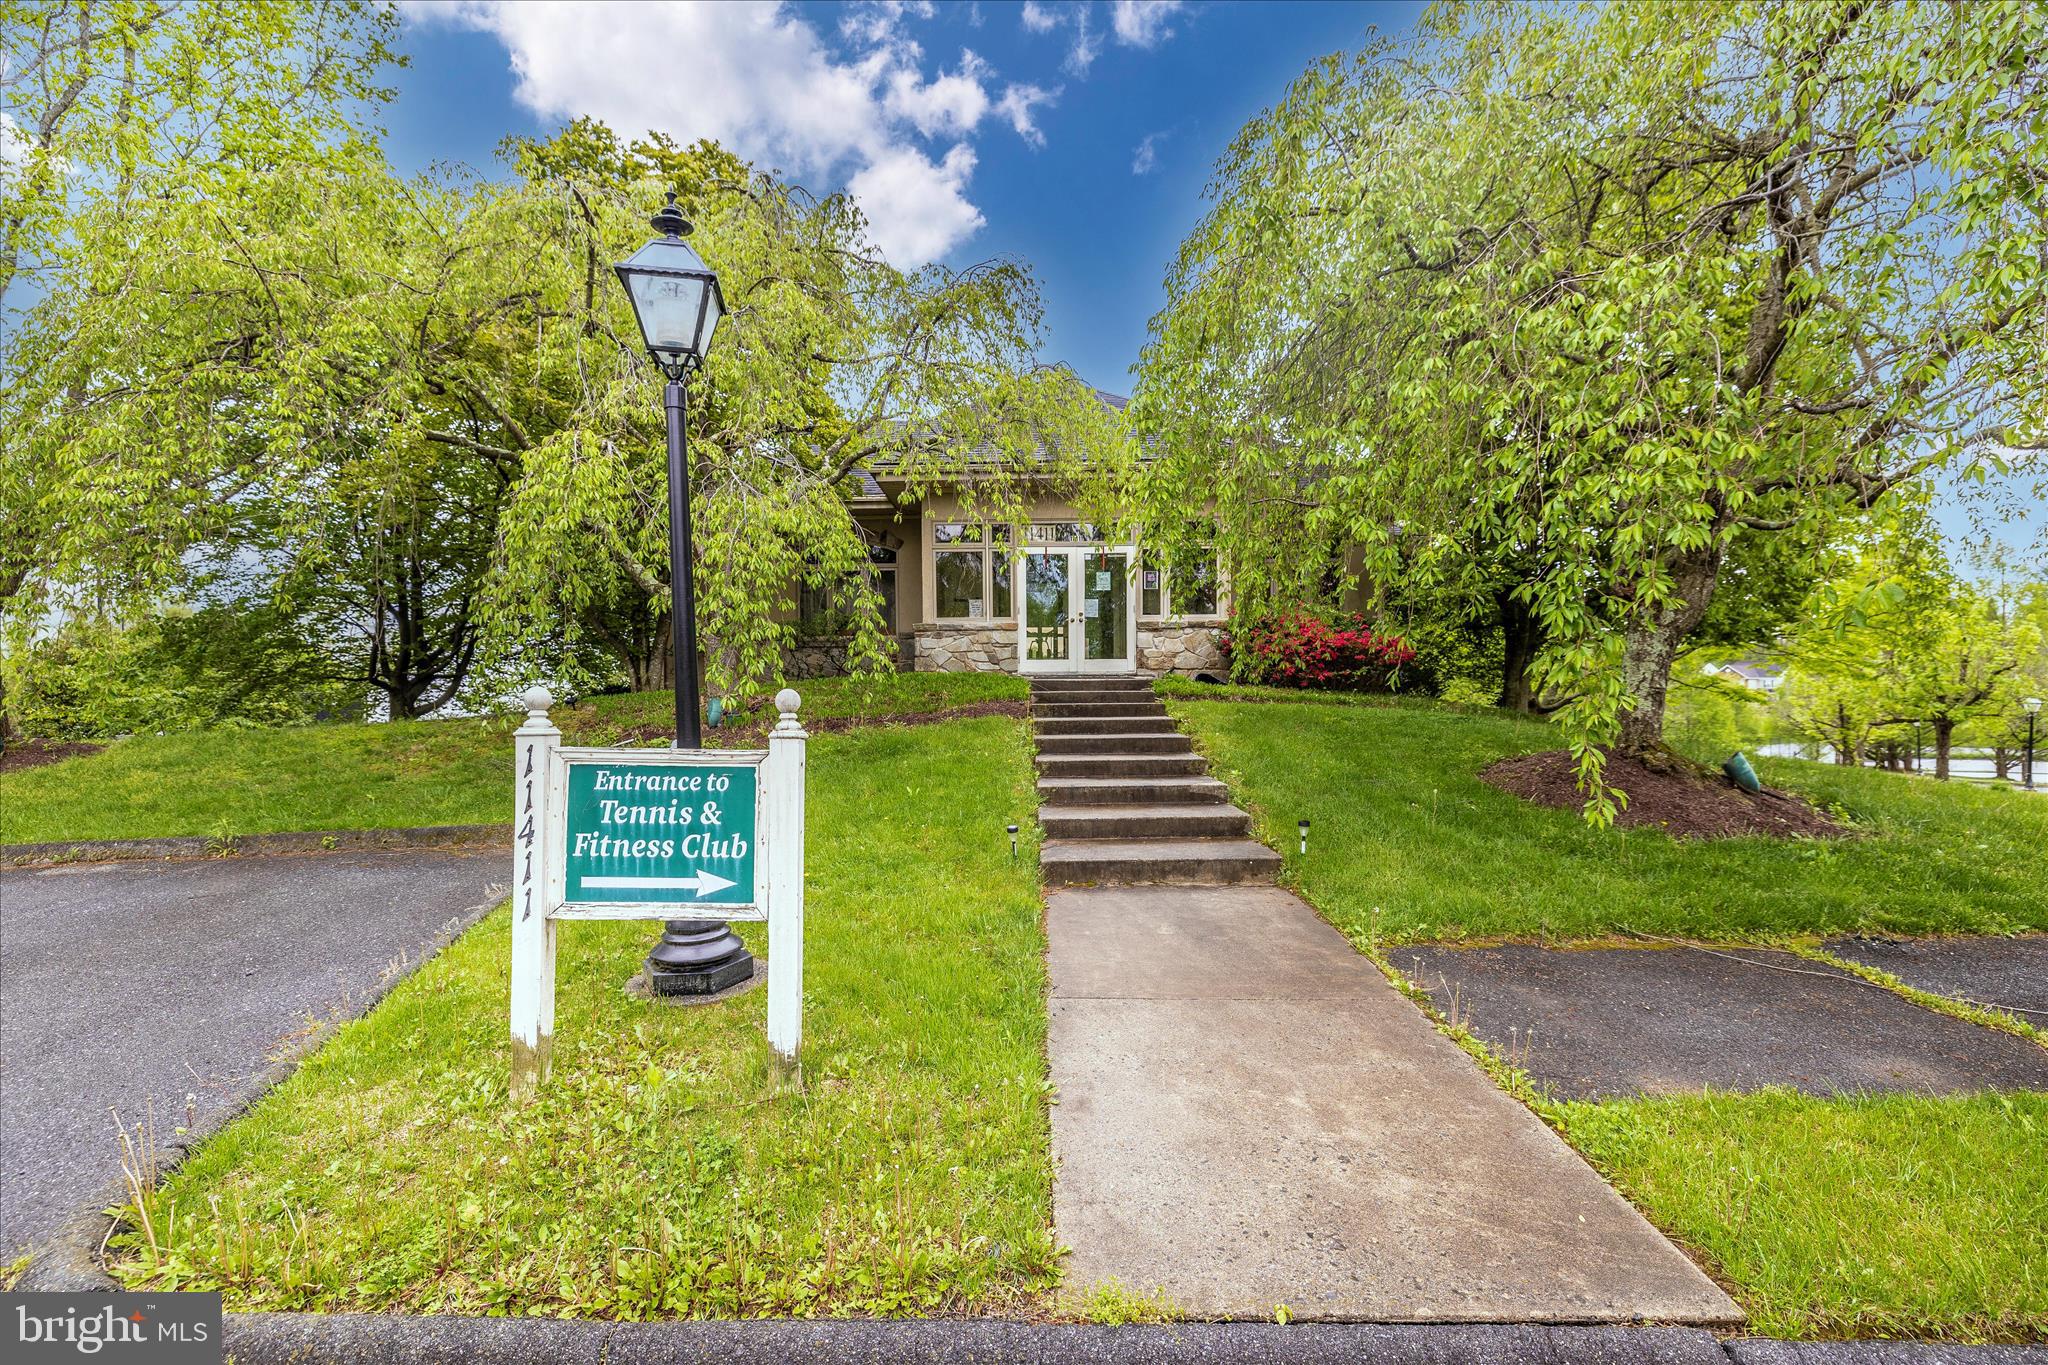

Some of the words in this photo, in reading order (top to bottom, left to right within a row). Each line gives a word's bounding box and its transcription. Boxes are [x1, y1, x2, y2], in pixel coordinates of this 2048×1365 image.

[593, 770, 702, 792] Entrance
[707, 772, 730, 792] to
[599, 798, 693, 825] Tennis
[700, 801, 722, 825] &
[517, 743, 535, 923] 11411
[572, 832, 675, 858] Fitness
[681, 832, 748, 860] Club
